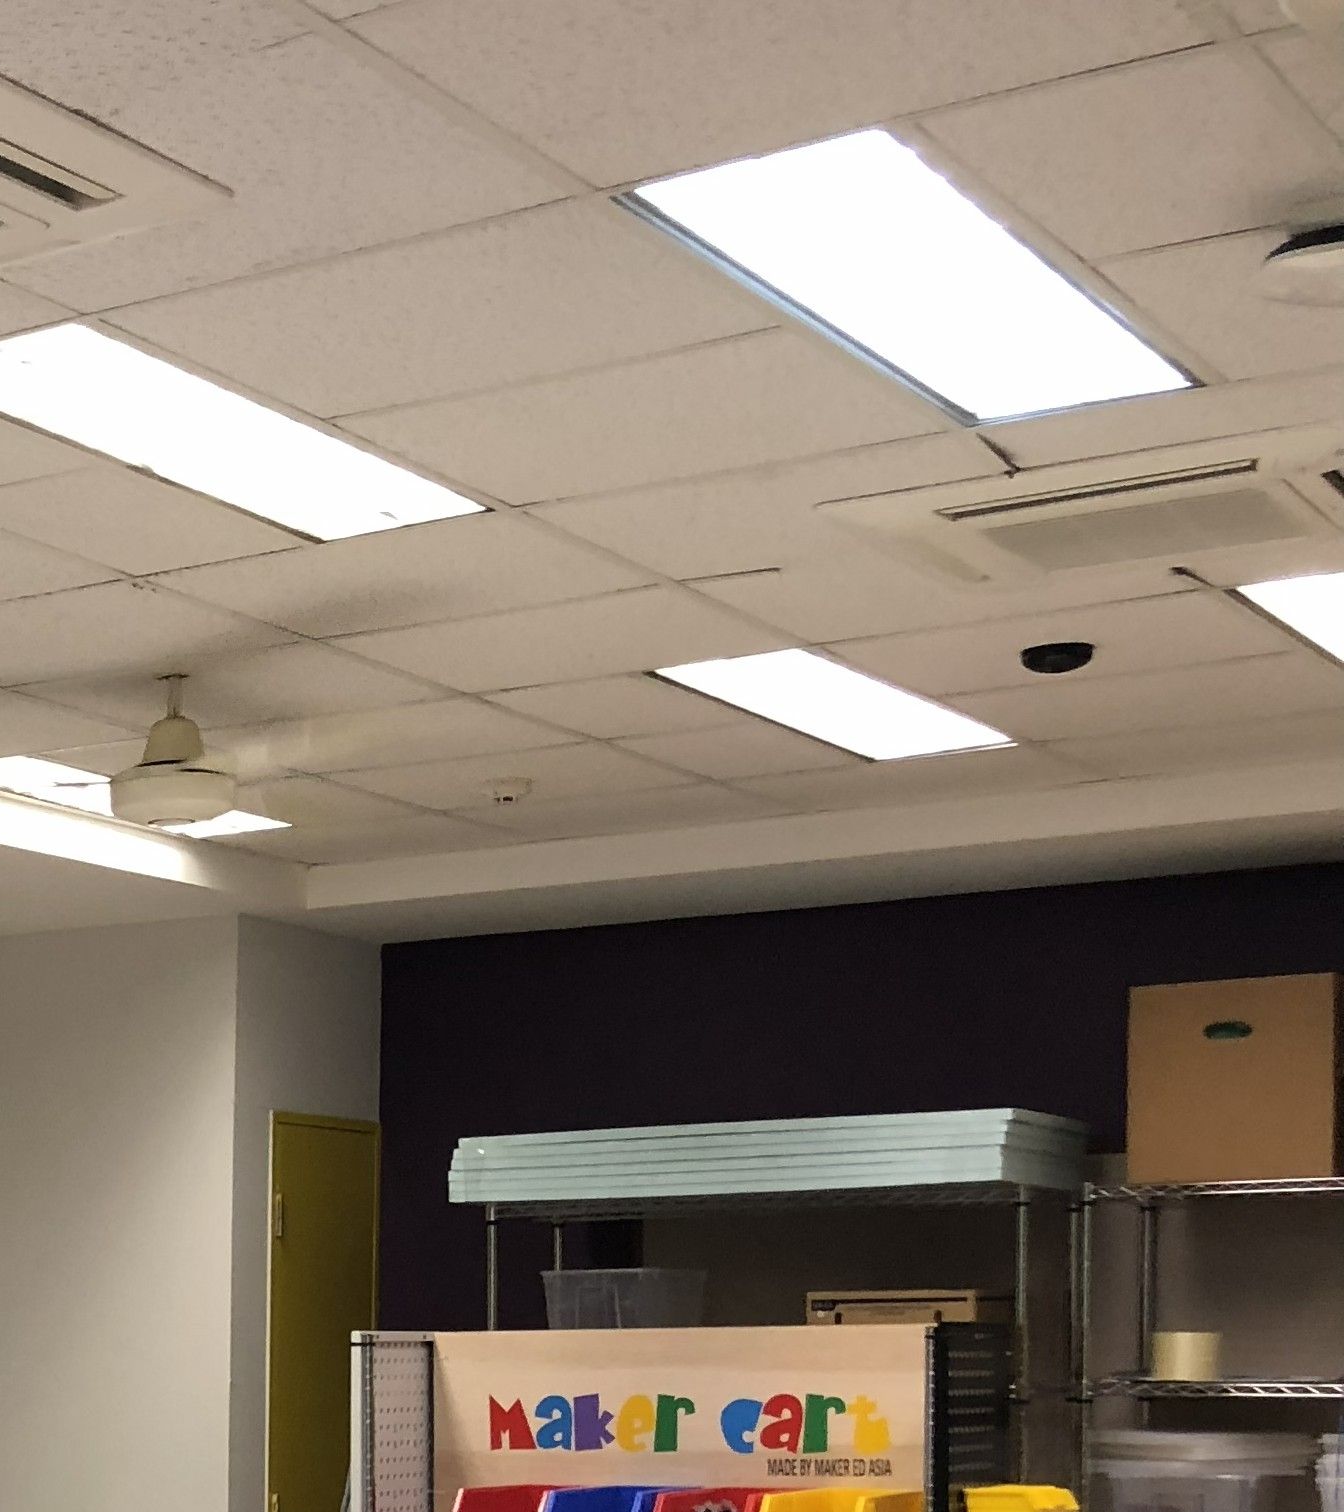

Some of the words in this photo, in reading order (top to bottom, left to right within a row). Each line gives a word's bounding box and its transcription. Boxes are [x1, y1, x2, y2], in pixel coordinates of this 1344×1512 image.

[488, 1392, 696, 1453] Maker
[767, 1458, 796, 1476] MADE
[799, 1459, 812, 1476] BY
[814, 1459, 850, 1477] MAKER
[852, 1459, 866, 1477] ED
[868, 1459, 893, 1477] ASIA
